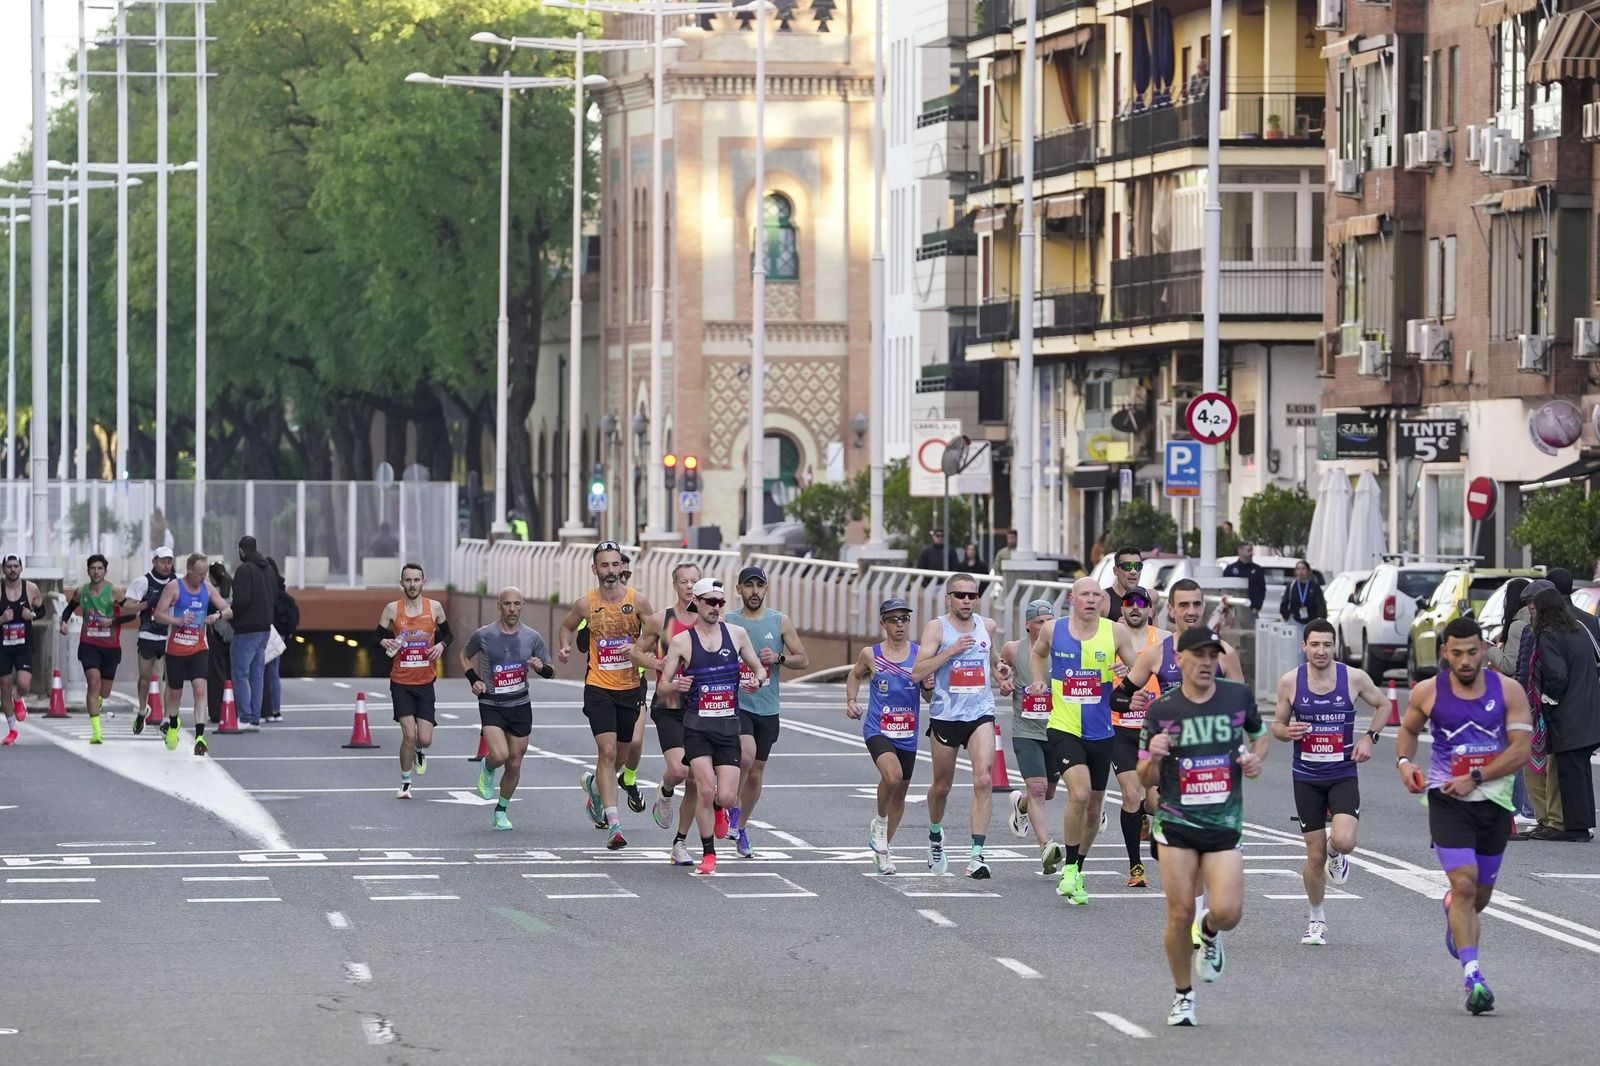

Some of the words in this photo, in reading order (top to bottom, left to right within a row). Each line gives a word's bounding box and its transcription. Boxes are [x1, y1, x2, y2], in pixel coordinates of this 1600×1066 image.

[1286, 404, 1317, 414] LUIS
[1400, 422, 1457, 437] TINTE
[1414, 437, 1450, 461] 5€
[1170, 446, 1192, 475] P
[608, 638, 629, 647] ZURICH
[406, 654, 423, 662] KEVIN
[498, 678, 522, 687] ROJANO
[1071, 687, 1093, 696] MARK
[704, 701, 730, 710] VEDERE
[1033, 703, 1047, 711] SEO
[886, 722, 909, 731] OSCAR
[1180, 714, 1231, 748] AVS
[1311, 744, 1334, 753] VONO
[1469, 745, 1497, 753] ZURICH
[1195, 758, 1224, 768] ZURICH
[1186, 781, 1227, 793] ANTONIO
